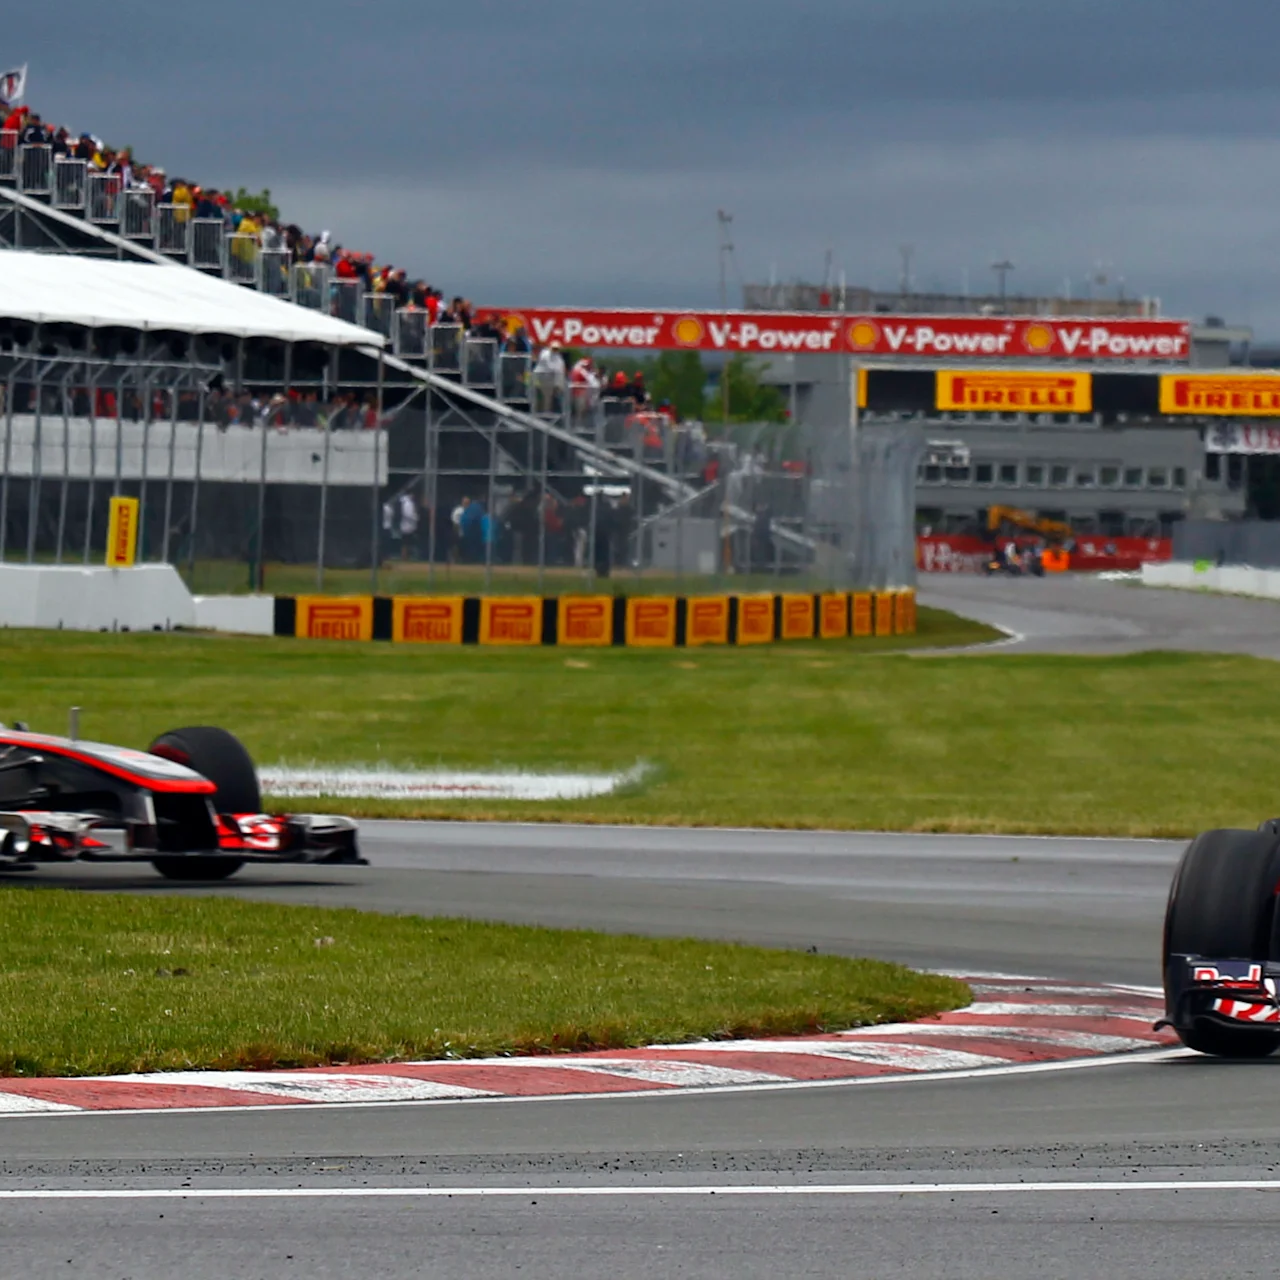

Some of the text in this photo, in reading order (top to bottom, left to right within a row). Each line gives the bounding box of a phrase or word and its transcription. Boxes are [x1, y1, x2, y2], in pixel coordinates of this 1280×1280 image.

[532, 319, 1186, 353] V-Power V-Power V-Power V-Power
[951, 376, 1076, 405] PIRELLI
[308, 605, 361, 640] PIRELLI
